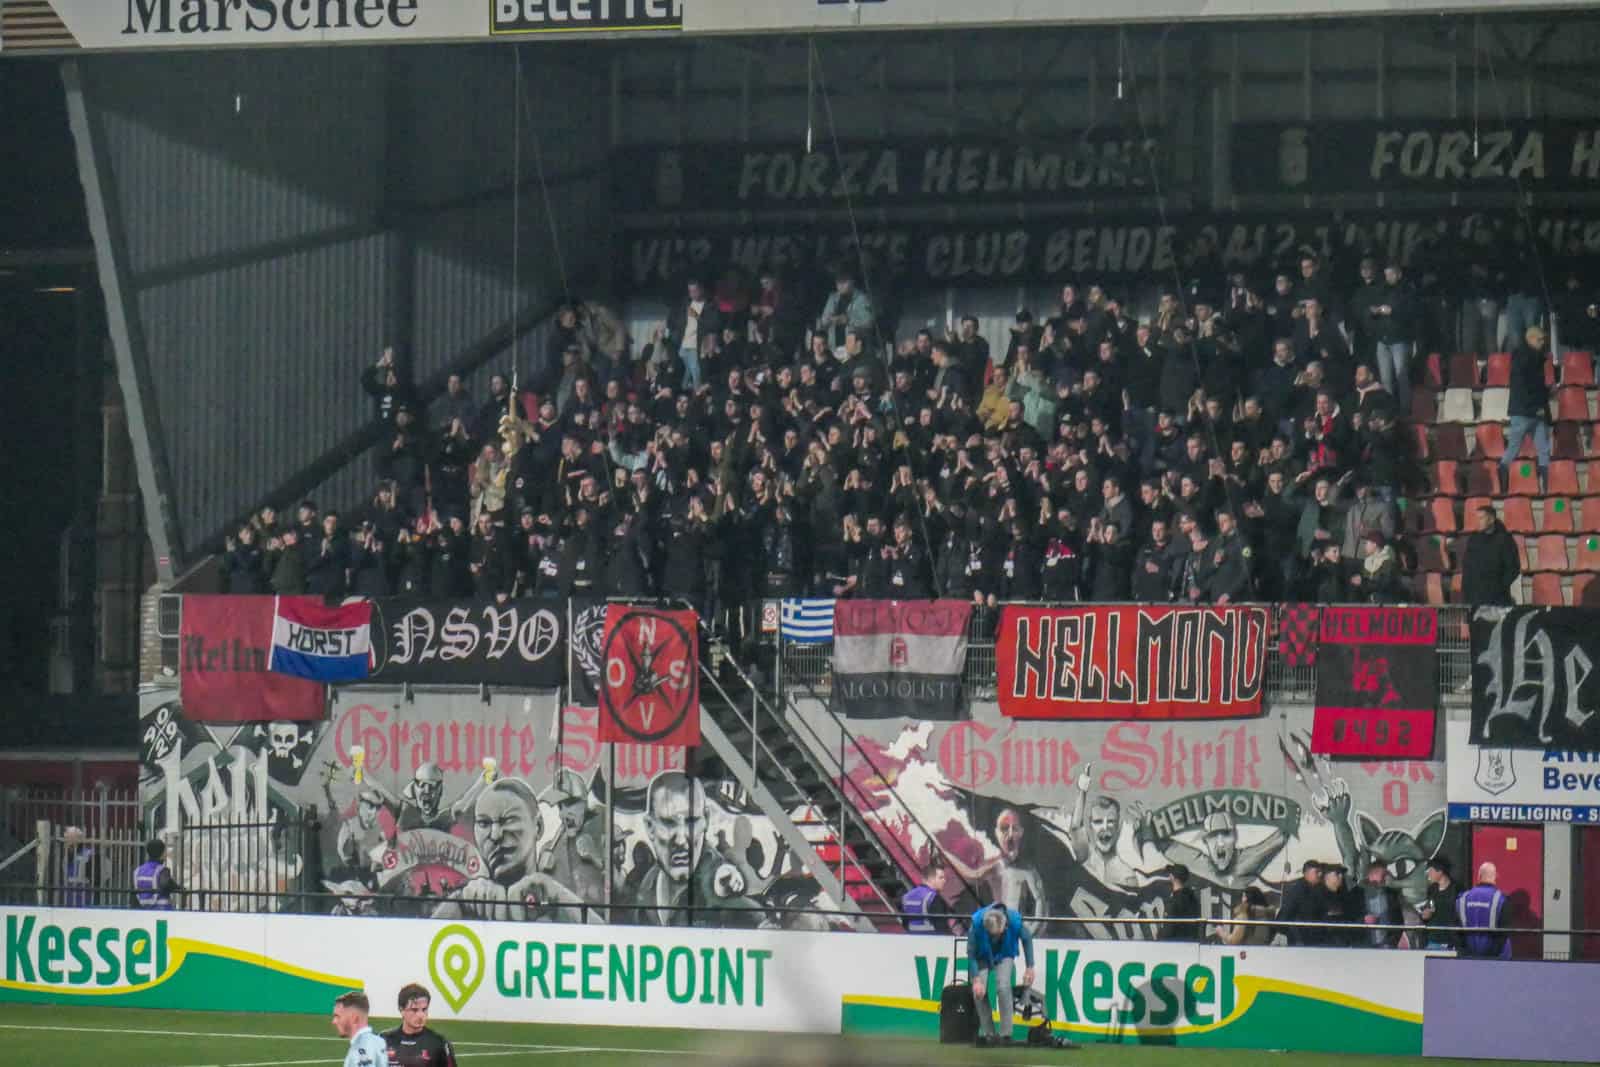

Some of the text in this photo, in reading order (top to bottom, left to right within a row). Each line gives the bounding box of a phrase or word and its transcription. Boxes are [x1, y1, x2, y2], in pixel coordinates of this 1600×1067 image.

[739, 149, 898, 199] FORZA
[1369, 127, 1545, 180] FORZA
[926, 228, 1031, 278] CLUB
[287, 623, 354, 655] HORST
[1325, 611, 1432, 638] HELMOND
[1013, 607, 1268, 705] HELLMOND
[1152, 794, 1289, 839] HELLMOND
[1469, 804, 1573, 821] BEVEILIGING
[7, 914, 169, 986] Kessel
[495, 939, 772, 1008] GREENPOINT
[1045, 948, 1236, 1026] Kessel
